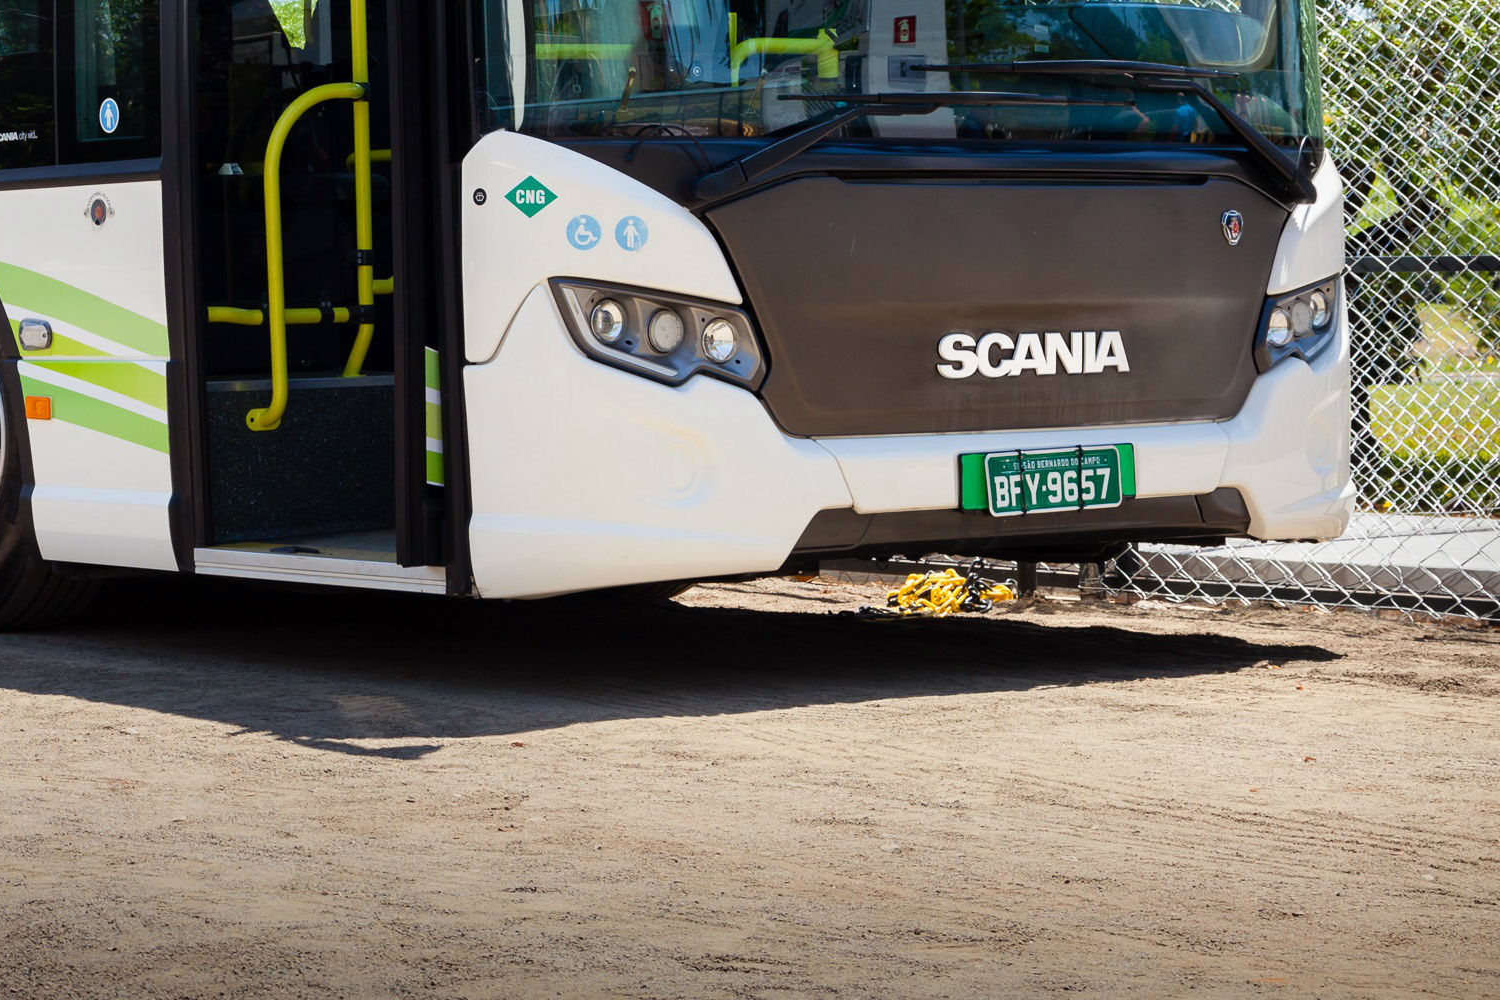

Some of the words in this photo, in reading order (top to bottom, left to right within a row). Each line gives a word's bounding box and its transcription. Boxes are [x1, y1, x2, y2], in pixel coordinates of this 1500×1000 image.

[515, 189, 546, 205] CNG
[936, 330, 1130, 380] SCANIA
[1023, 460, 1035, 470] SÃO
[1037, 458, 1069, 469] BERNARDO
[1071, 457, 1078, 466] DO
[1081, 456, 1101, 466] CAMPO
